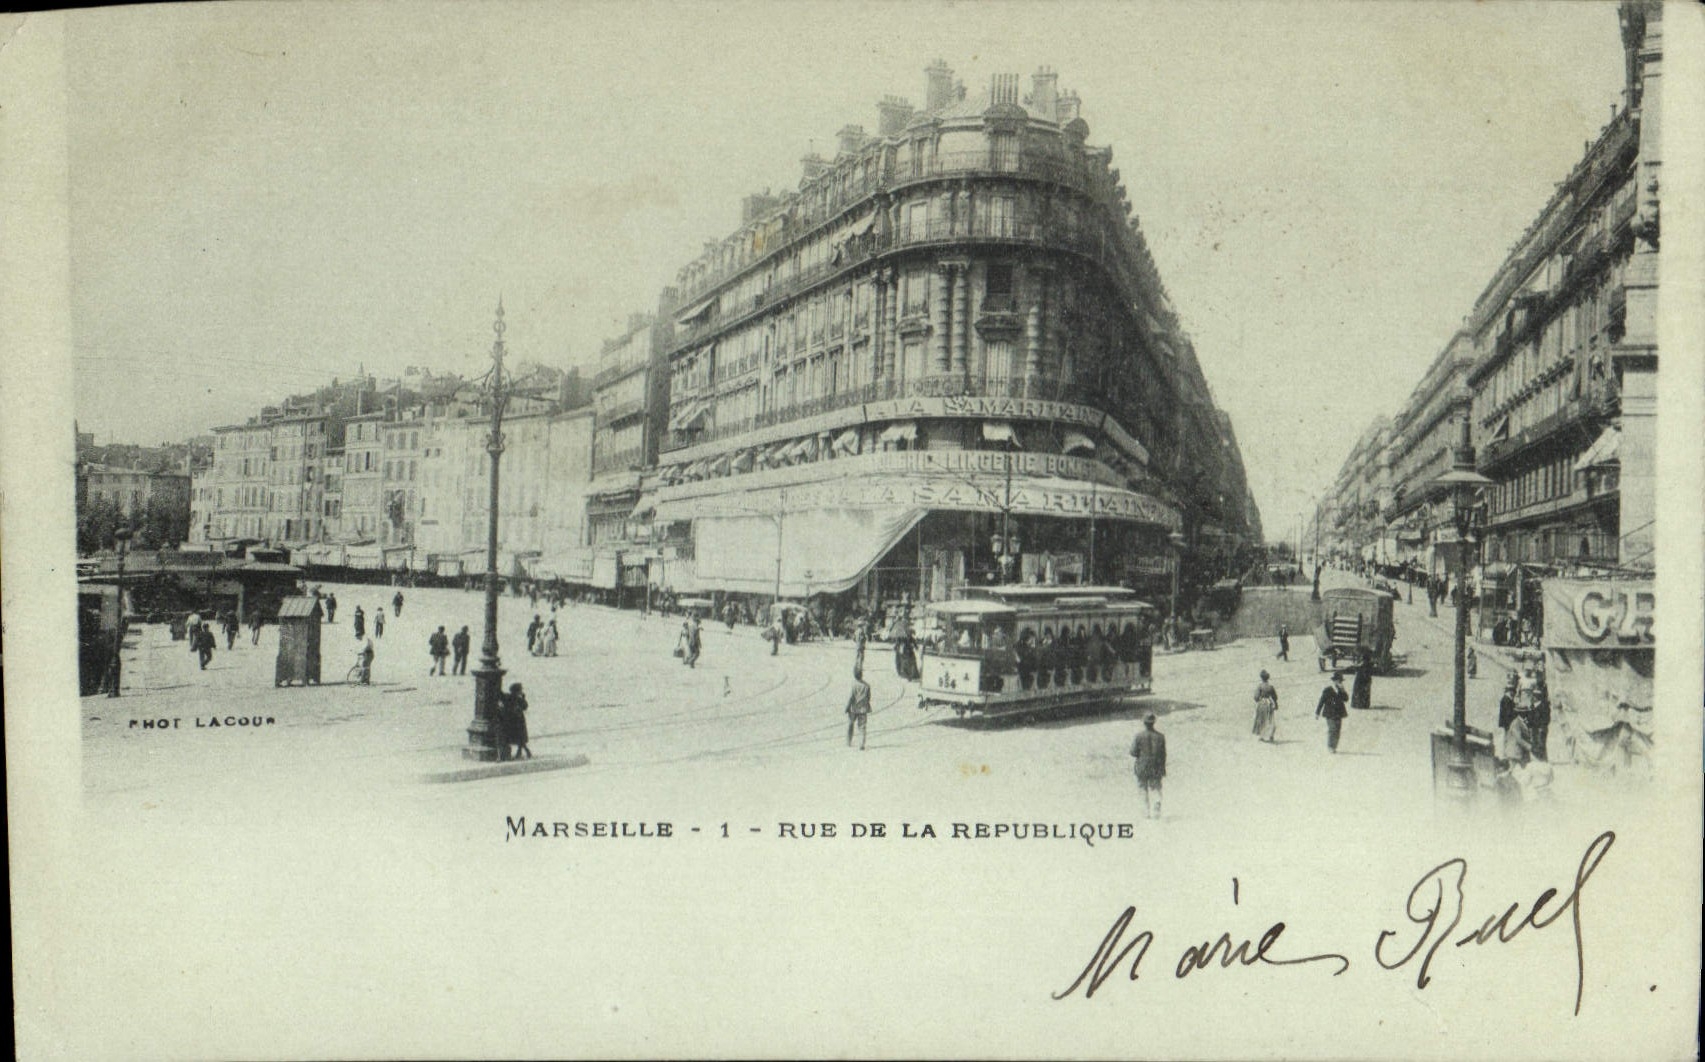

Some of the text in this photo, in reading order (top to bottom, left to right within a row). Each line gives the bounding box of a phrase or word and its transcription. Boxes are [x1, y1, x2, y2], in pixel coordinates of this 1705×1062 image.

[893, 398, 933, 418] LA
[945, 451, 1038, 475] LINGERIE
[1053, 877, 1349, 1000] Marie
